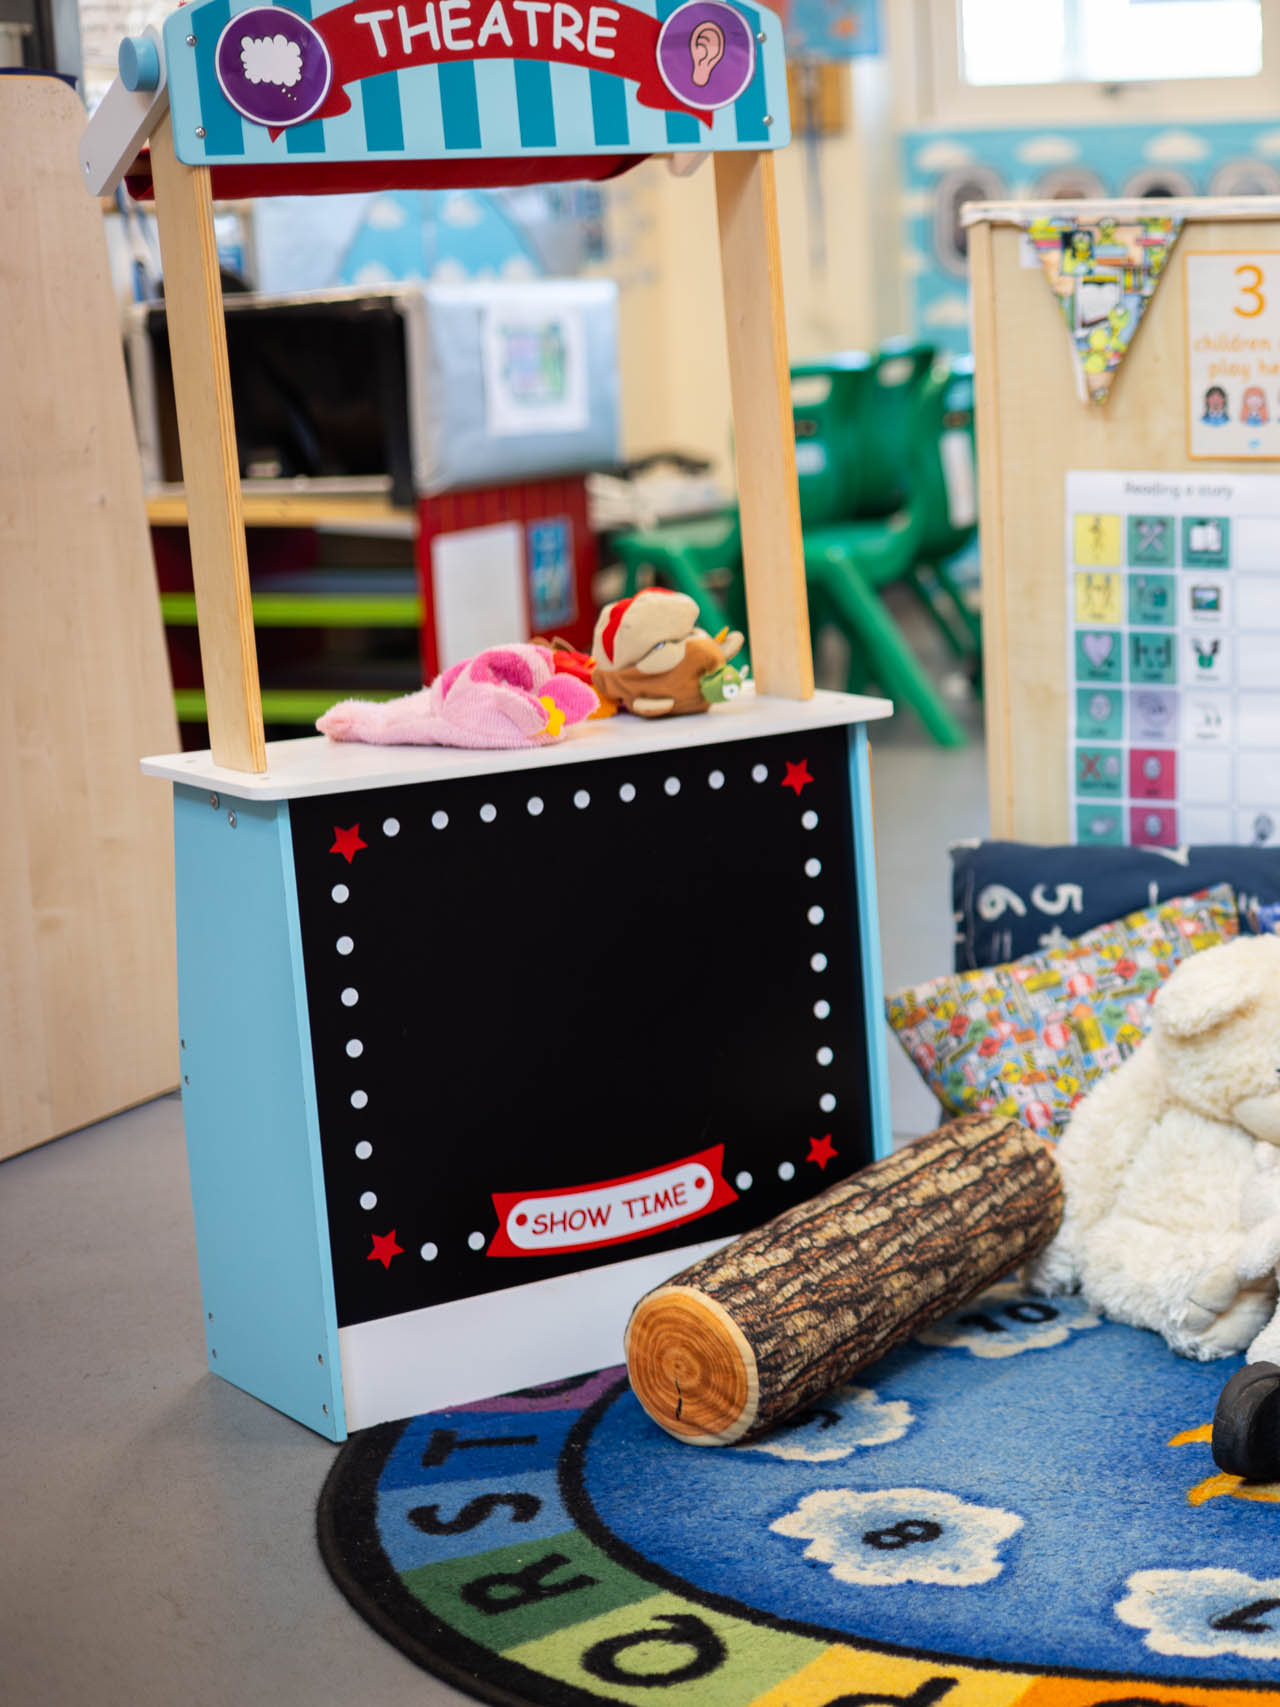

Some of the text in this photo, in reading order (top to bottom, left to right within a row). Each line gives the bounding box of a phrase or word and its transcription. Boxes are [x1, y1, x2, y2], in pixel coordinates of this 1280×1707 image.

[354, 0, 622, 58] THEATRE
[1232, 264, 1266, 318] 3
[1193, 331, 1272, 352] children
[1208, 356, 1250, 383] play
[531, 1182, 688, 1236] SHOW TIME
[421, 1429, 539, 1468] T
[408, 1491, 543, 1537] S
[861, 1518, 944, 1550] 8
[460, 1553, 600, 1616] R
[580, 1612, 730, 1689] Q
